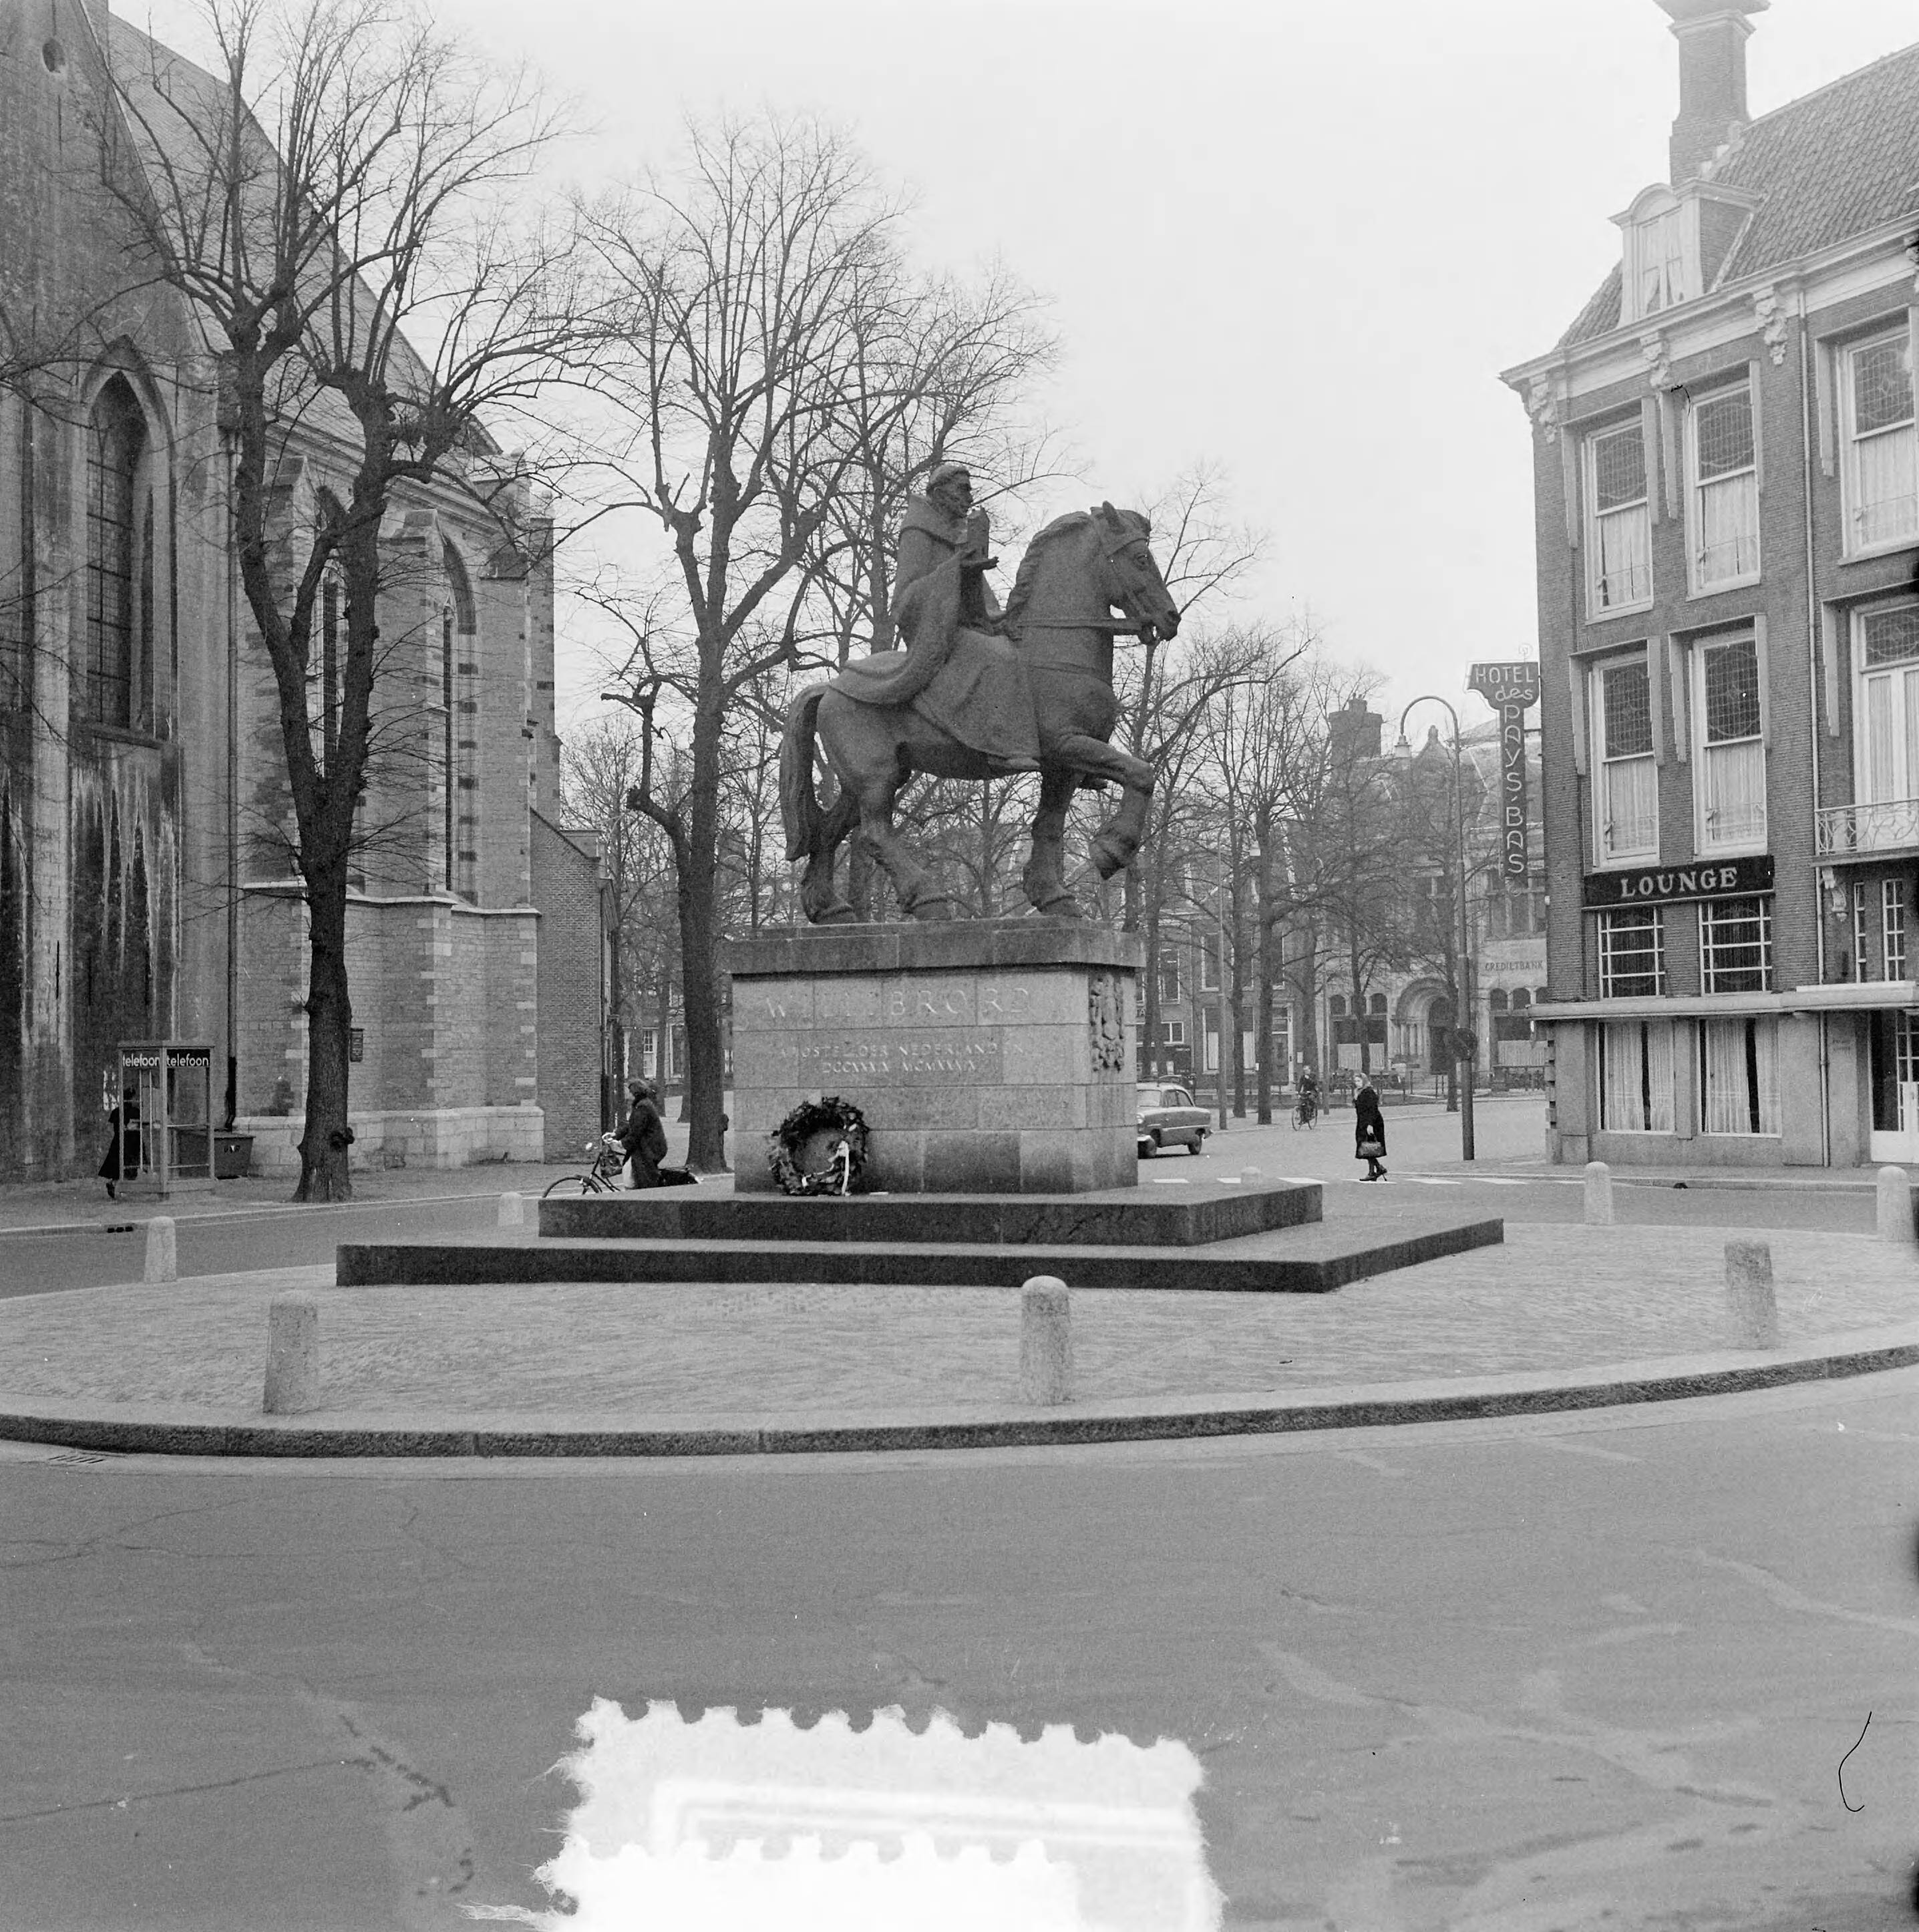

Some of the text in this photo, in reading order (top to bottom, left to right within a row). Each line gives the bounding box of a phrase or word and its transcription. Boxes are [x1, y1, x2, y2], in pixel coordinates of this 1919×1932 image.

[1475, 666, 1534, 684] HOTEL
[1496, 685, 1534, 702] des
[1620, 867, 1737, 898] LOUNGE
[123, 1052, 209, 1067] telefoon telefoon
